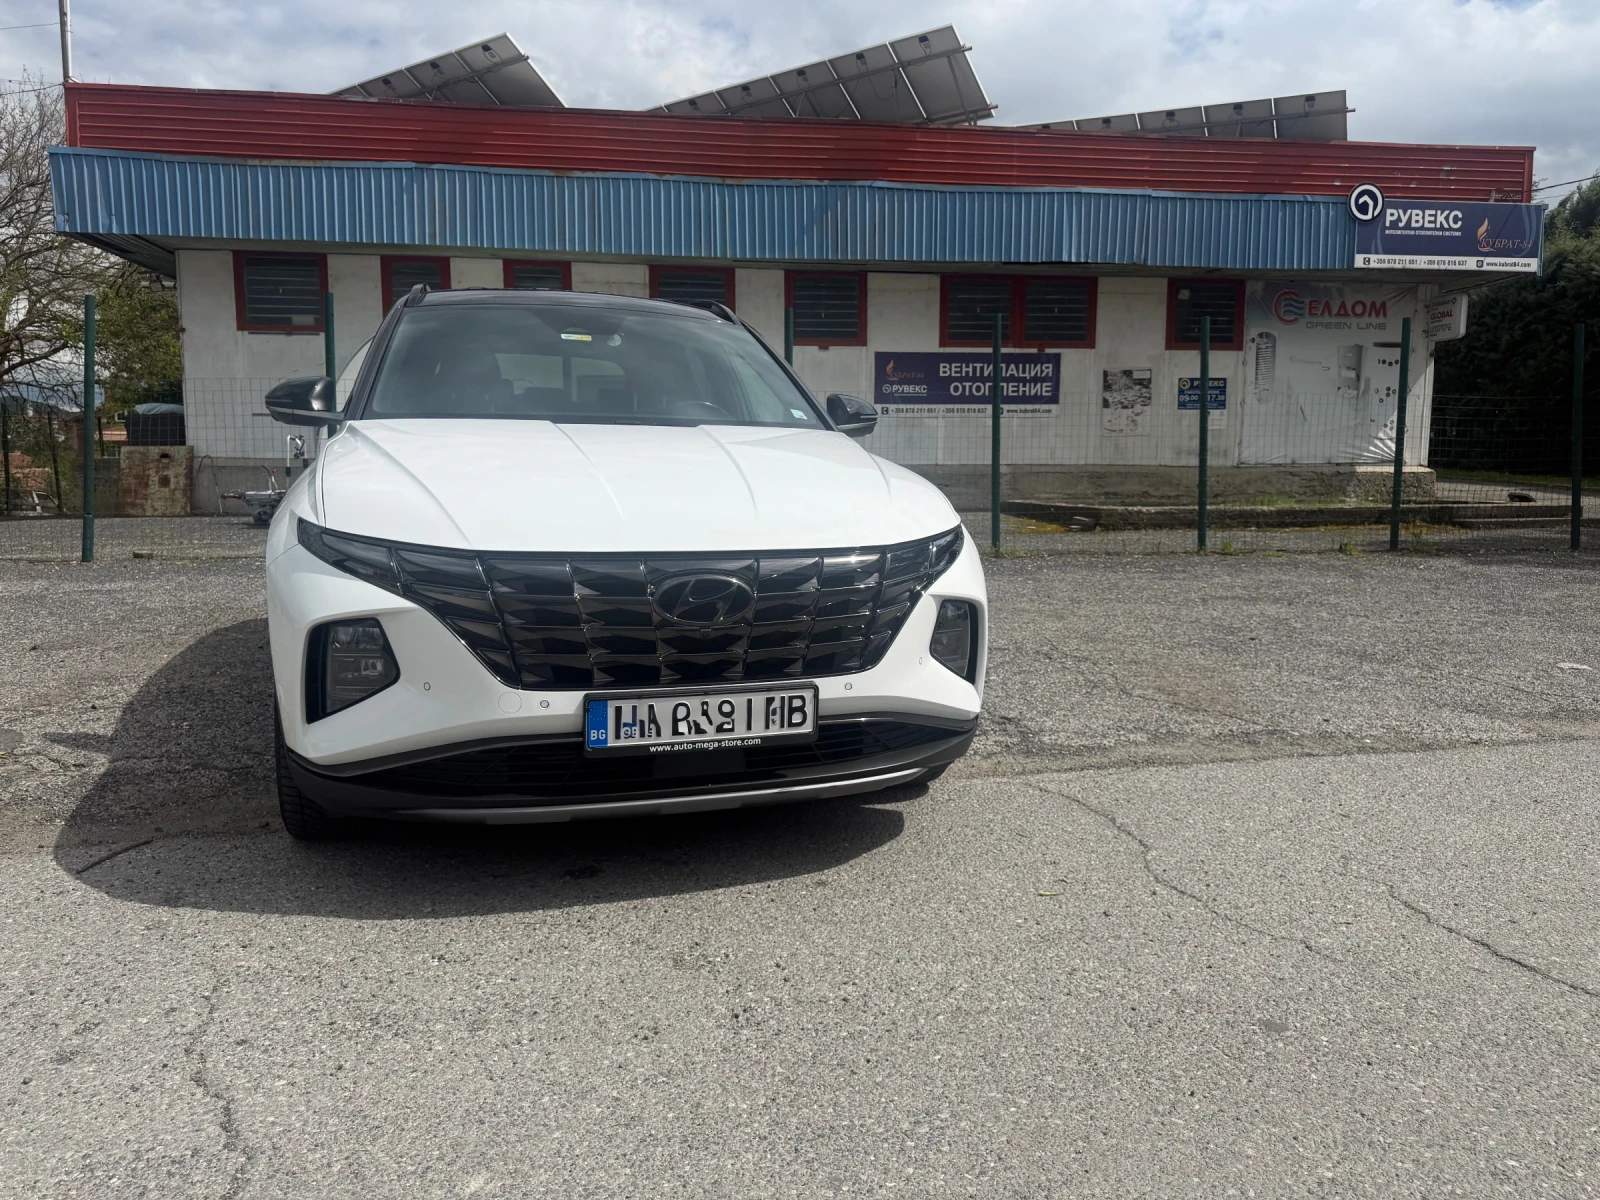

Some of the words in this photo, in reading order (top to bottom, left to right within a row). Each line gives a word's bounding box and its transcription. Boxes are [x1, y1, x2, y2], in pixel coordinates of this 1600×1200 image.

[1385, 208, 1463, 229] РУВЕКС
[1481, 238, 1533, 249] КУБРАТ-84
[1307, 299, 1387, 318] ЕЛДОМ
[1430, 310, 1453, 320] GLOBAL
[1357, 322, 1387, 330] LINE
[892, 384, 928, 393] РУВЕКС
[590, 729, 606, 741] BG
[649, 738, 762, 752] www.auto-mega-store.com
